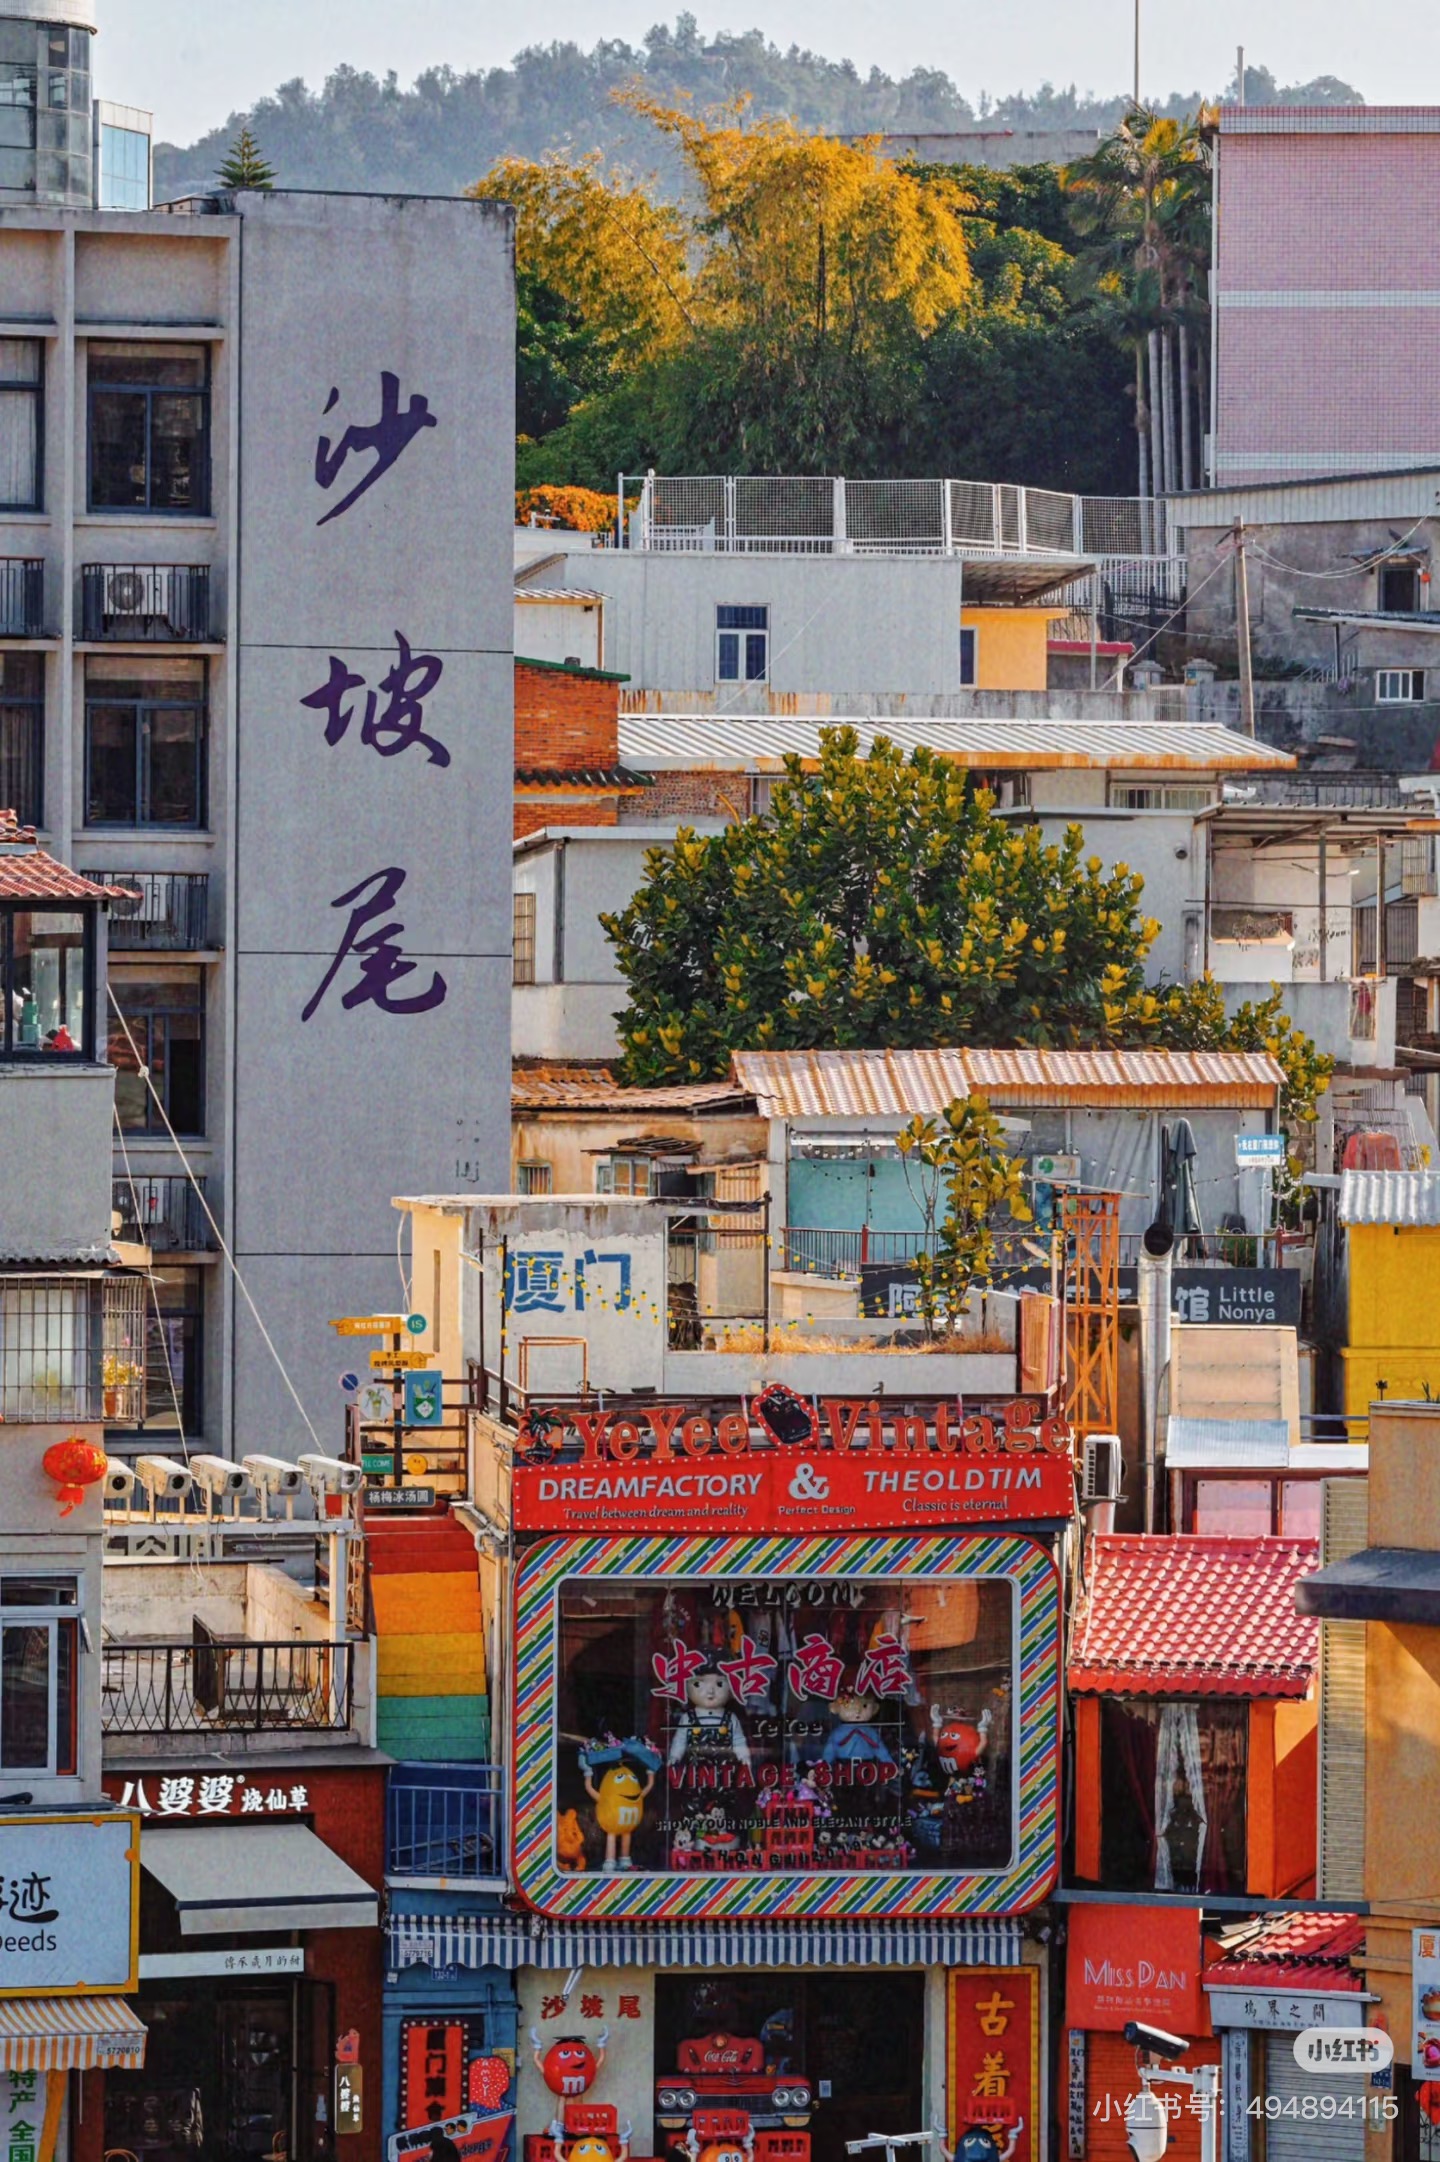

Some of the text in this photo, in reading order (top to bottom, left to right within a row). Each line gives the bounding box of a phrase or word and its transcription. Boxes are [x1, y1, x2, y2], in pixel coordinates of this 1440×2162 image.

[301, 371, 450, 1022] 沙坡尾
[505, 1249, 630, 1313] 厦门
[1220, 1286, 1275, 1303] Little
[1219, 1305, 1276, 1323] Nonya
[569, 1398, 1071, 1463] YeYee Vintage
[538, 1462, 1043, 1501] DREAMFACTORY & THEOLDTIM
[563, 1502, 748, 1520] Travel between dream and reality
[778, 1504, 856, 1516] Perfect Design
[903, 1496, 1009, 1513] Classic is eternal
[651, 1632, 913, 1705] 中古商店
[667, 1761, 900, 1790] VINTAGE SHOP
[119, 1775, 309, 1817] 八婆婆 烧仙草
[0, 1872, 59, 1923] 迹
[0, 1929, 57, 1952] eeds
[1418, 1935, 1440, 1958] 厦
[541, 1993, 641, 2020] 沙坡尾
